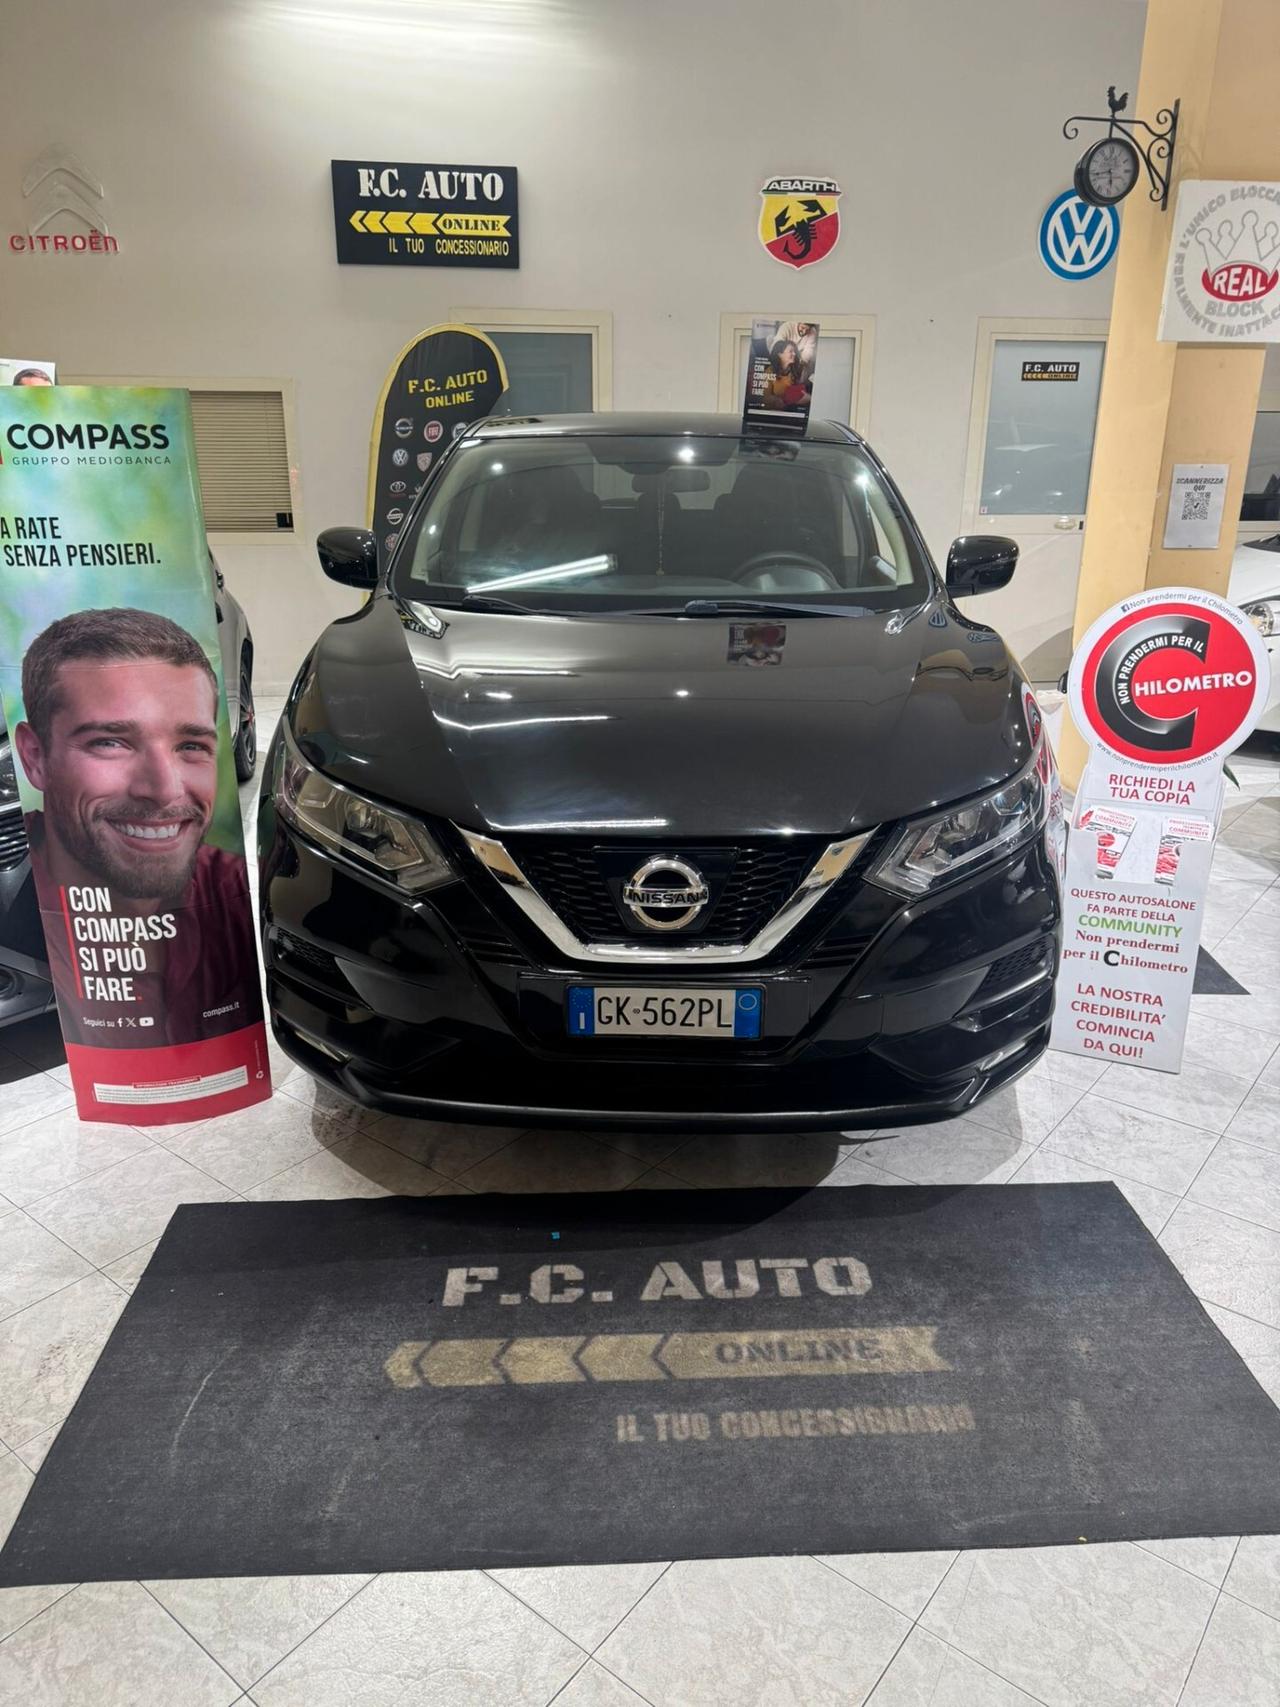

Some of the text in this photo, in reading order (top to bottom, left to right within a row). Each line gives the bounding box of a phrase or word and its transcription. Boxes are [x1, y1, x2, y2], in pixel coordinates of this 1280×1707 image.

[358, 168, 504, 201] F.C. AUTO
[768, 180, 836, 191] ABARTH
[442, 218, 501, 232] ONLINE
[389, 238, 509, 257] IL TUO CONCESSIONARIO
[1174, 252, 1217, 334] REALMENTE
[1213, 267, 1266, 296] REAL
[1204, 300, 1265, 318] BLOCK
[1025, 364, 1077, 373] F.C. AUTO
[408, 369, 488, 394] F.C. AUTO
[425, 390, 475, 409] ONLINE
[7, 423, 170, 450] COMPASS
[12, 456, 171, 466] GRUPPO MEDIOBANCA
[0, 516, 62, 540] A RATE
[5, 542, 161, 567] SENZA PENSIERI.
[1130, 592, 1242, 625] Non prendermi per il Chilometro
[1117, 635, 1204, 705] NON PRENDERMI PER IL
[1109, 774, 1196, 793] RICHIEDI LA
[1110, 786, 1190, 805] TUA COPIA
[69, 886, 112, 913] CON
[631, 892, 701, 904] NISSAN
[1071, 888, 1196, 911] QUESTO AUTOSALONE
[1087, 904, 1176, 922] FA PARTE DELLA
[74, 913, 177, 943] COMPASS
[1078, 915, 1183, 938] COMMUNITY
[1075, 930, 1179, 953] Non prendermi
[78, 942, 147, 972] SI PUÒ
[1063, 949, 1188, 974] per il Chilometro
[1077, 983, 1163, 1007] LA NOSTRA
[202, 1001, 240, 1018] compass.it
[82, 1017, 115, 1029] Seguici su
[1076, 1019, 1155, 1042] COMINCIA
[1083, 1038, 1143, 1058] DA QUI!
[442, 1256, 873, 1307] F.C. AUTO
[715, 1338, 883, 1365] ONLINE
[617, 1415, 644, 1442] IL
[653, 1412, 711, 1442] TUO
